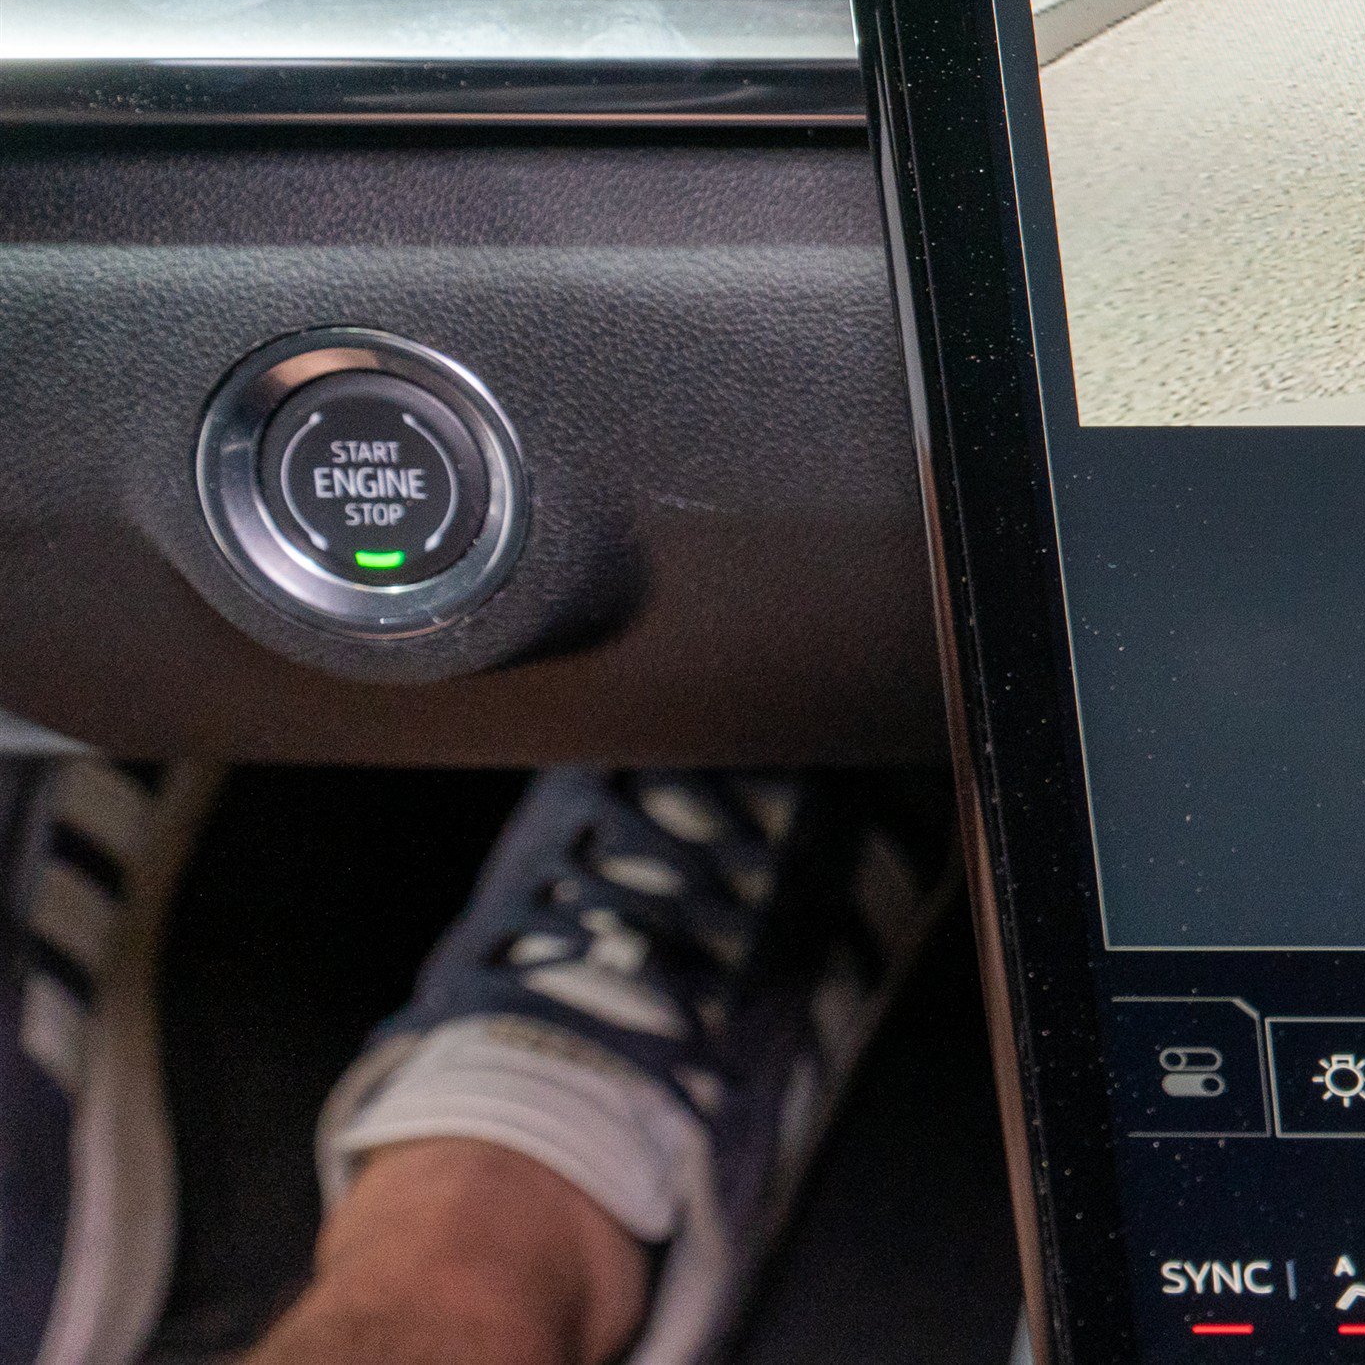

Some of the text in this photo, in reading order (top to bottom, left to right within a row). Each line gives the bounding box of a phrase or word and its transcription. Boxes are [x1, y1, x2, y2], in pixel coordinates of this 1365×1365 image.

[329, 439, 400, 465] START
[312, 466, 428, 500] ENGINE
[344, 503, 405, 527] STOP
[1160, 1260, 1274, 1295] SYNC
